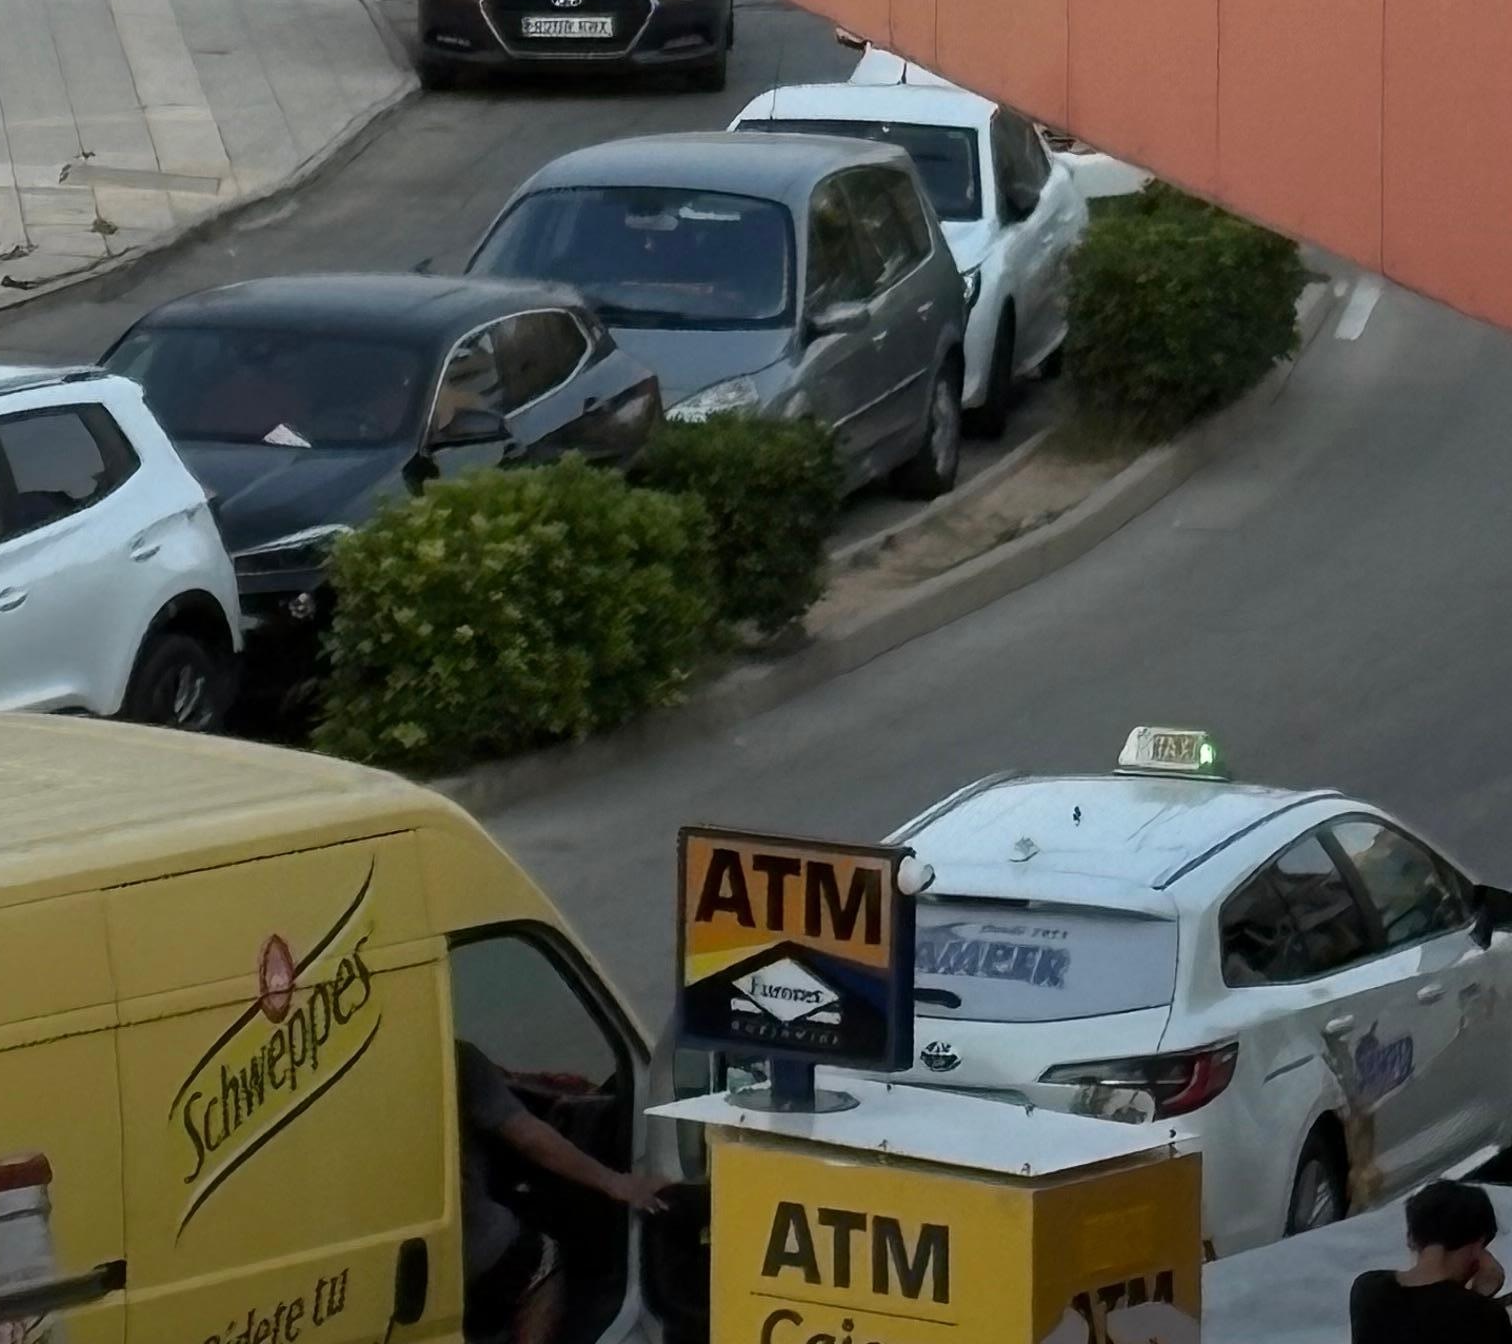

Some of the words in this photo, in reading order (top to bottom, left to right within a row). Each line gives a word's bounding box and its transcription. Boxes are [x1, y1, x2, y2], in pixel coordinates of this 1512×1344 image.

[694, 847, 882, 945] ATM
[184, 922, 374, 1184] Schweppes
[761, 1200, 950, 1305] ATM
